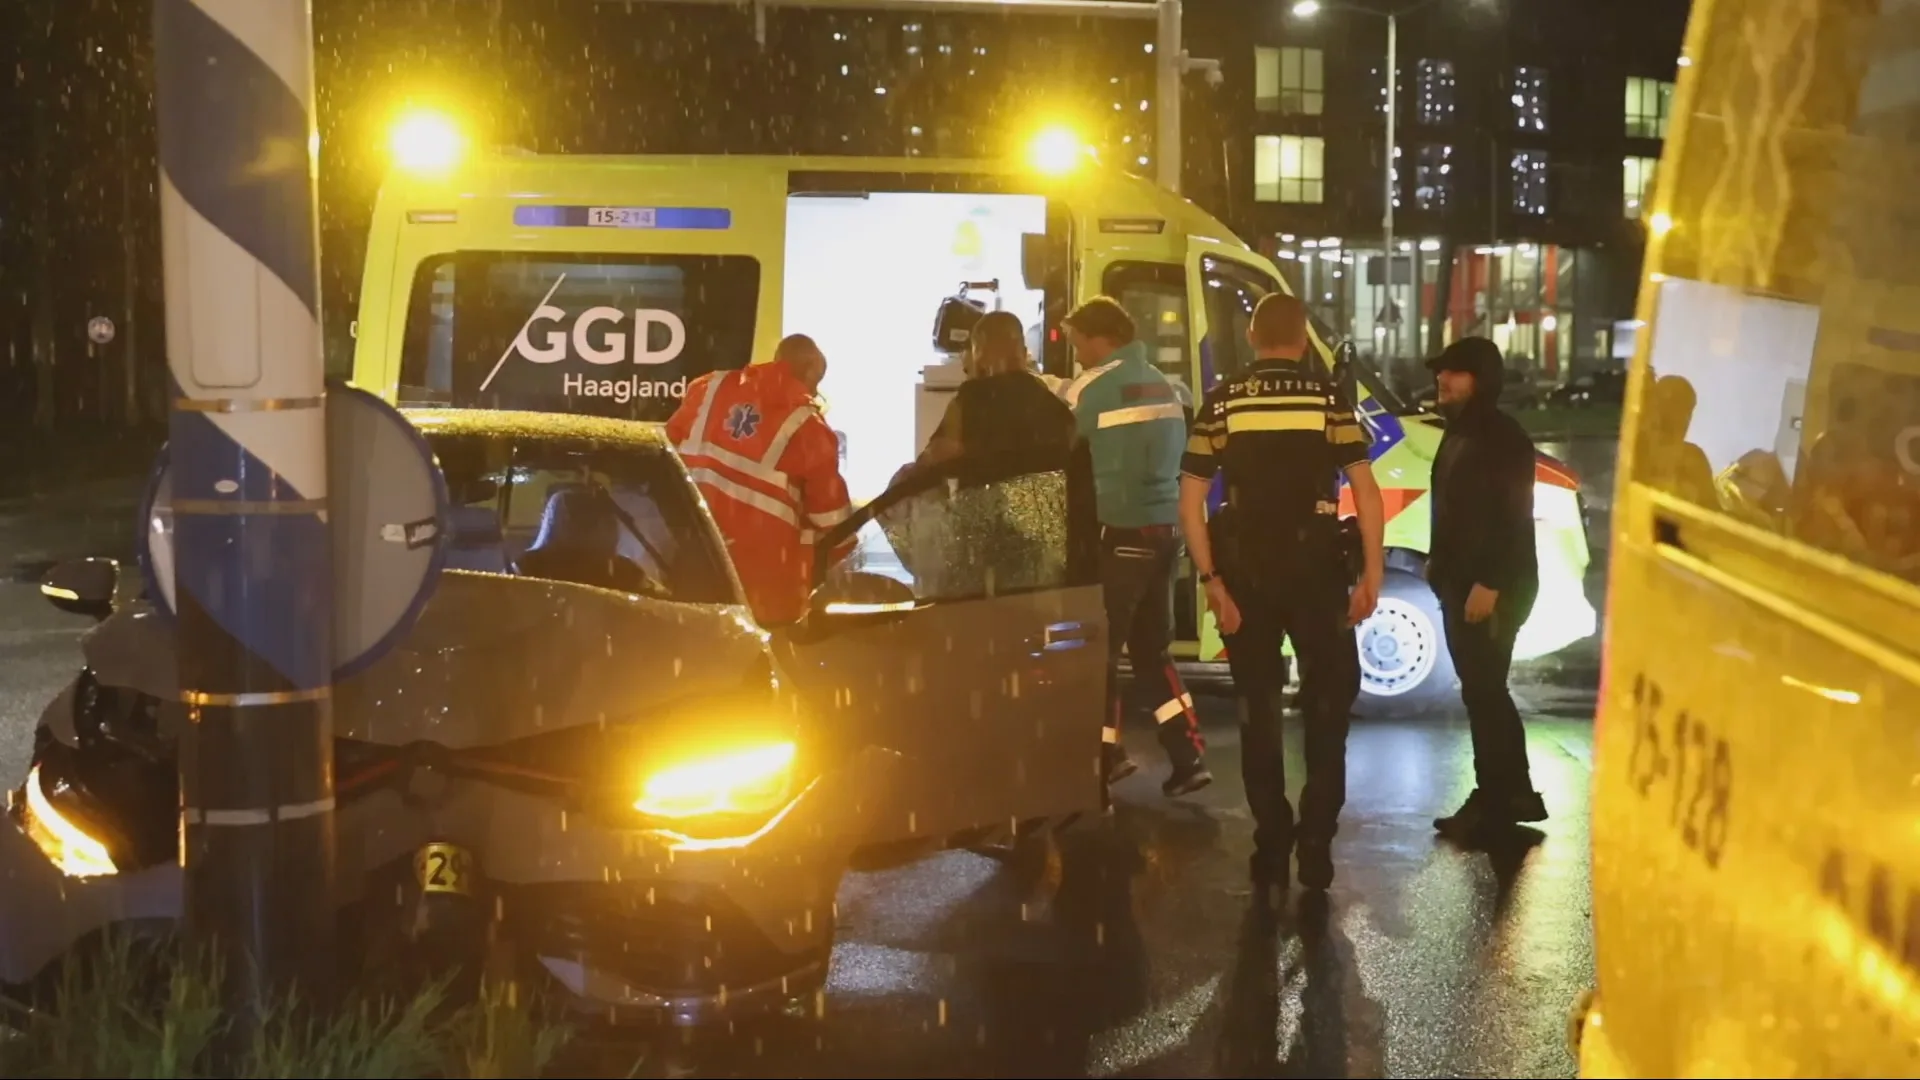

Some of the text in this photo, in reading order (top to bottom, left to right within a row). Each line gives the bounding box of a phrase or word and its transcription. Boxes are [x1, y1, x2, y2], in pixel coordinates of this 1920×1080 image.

[595, 210, 652, 224] 15-214
[515, 304, 686, 365] GGD
[563, 372, 687, 404] Haagland
